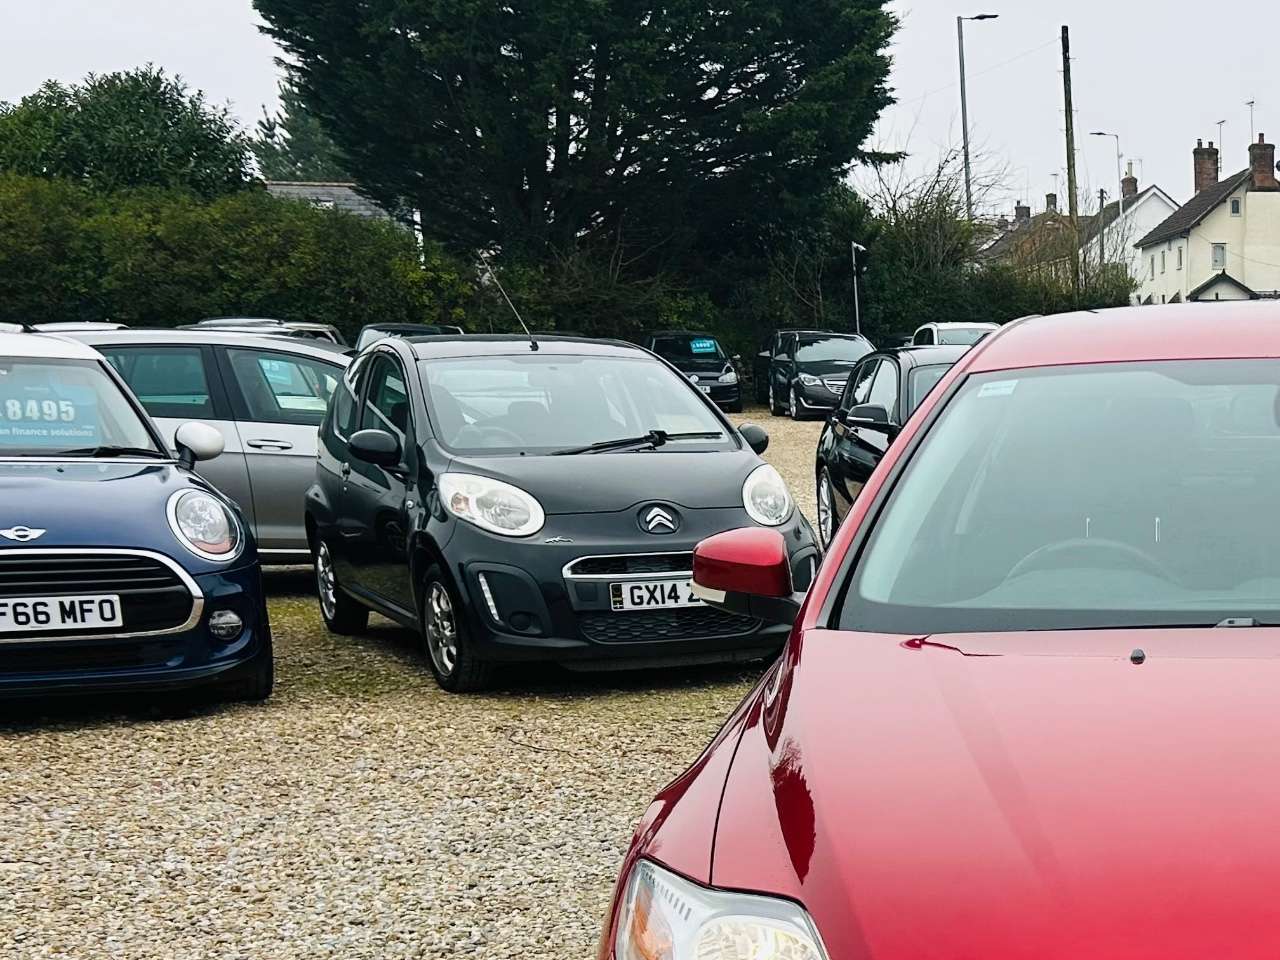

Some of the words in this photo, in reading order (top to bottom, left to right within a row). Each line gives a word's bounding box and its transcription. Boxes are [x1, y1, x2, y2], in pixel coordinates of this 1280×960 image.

[0, 399, 75, 422] 8495
[12, 427, 48, 436] finance
[629, 583, 680, 606] GX14
[58, 599, 116, 624] MFO
